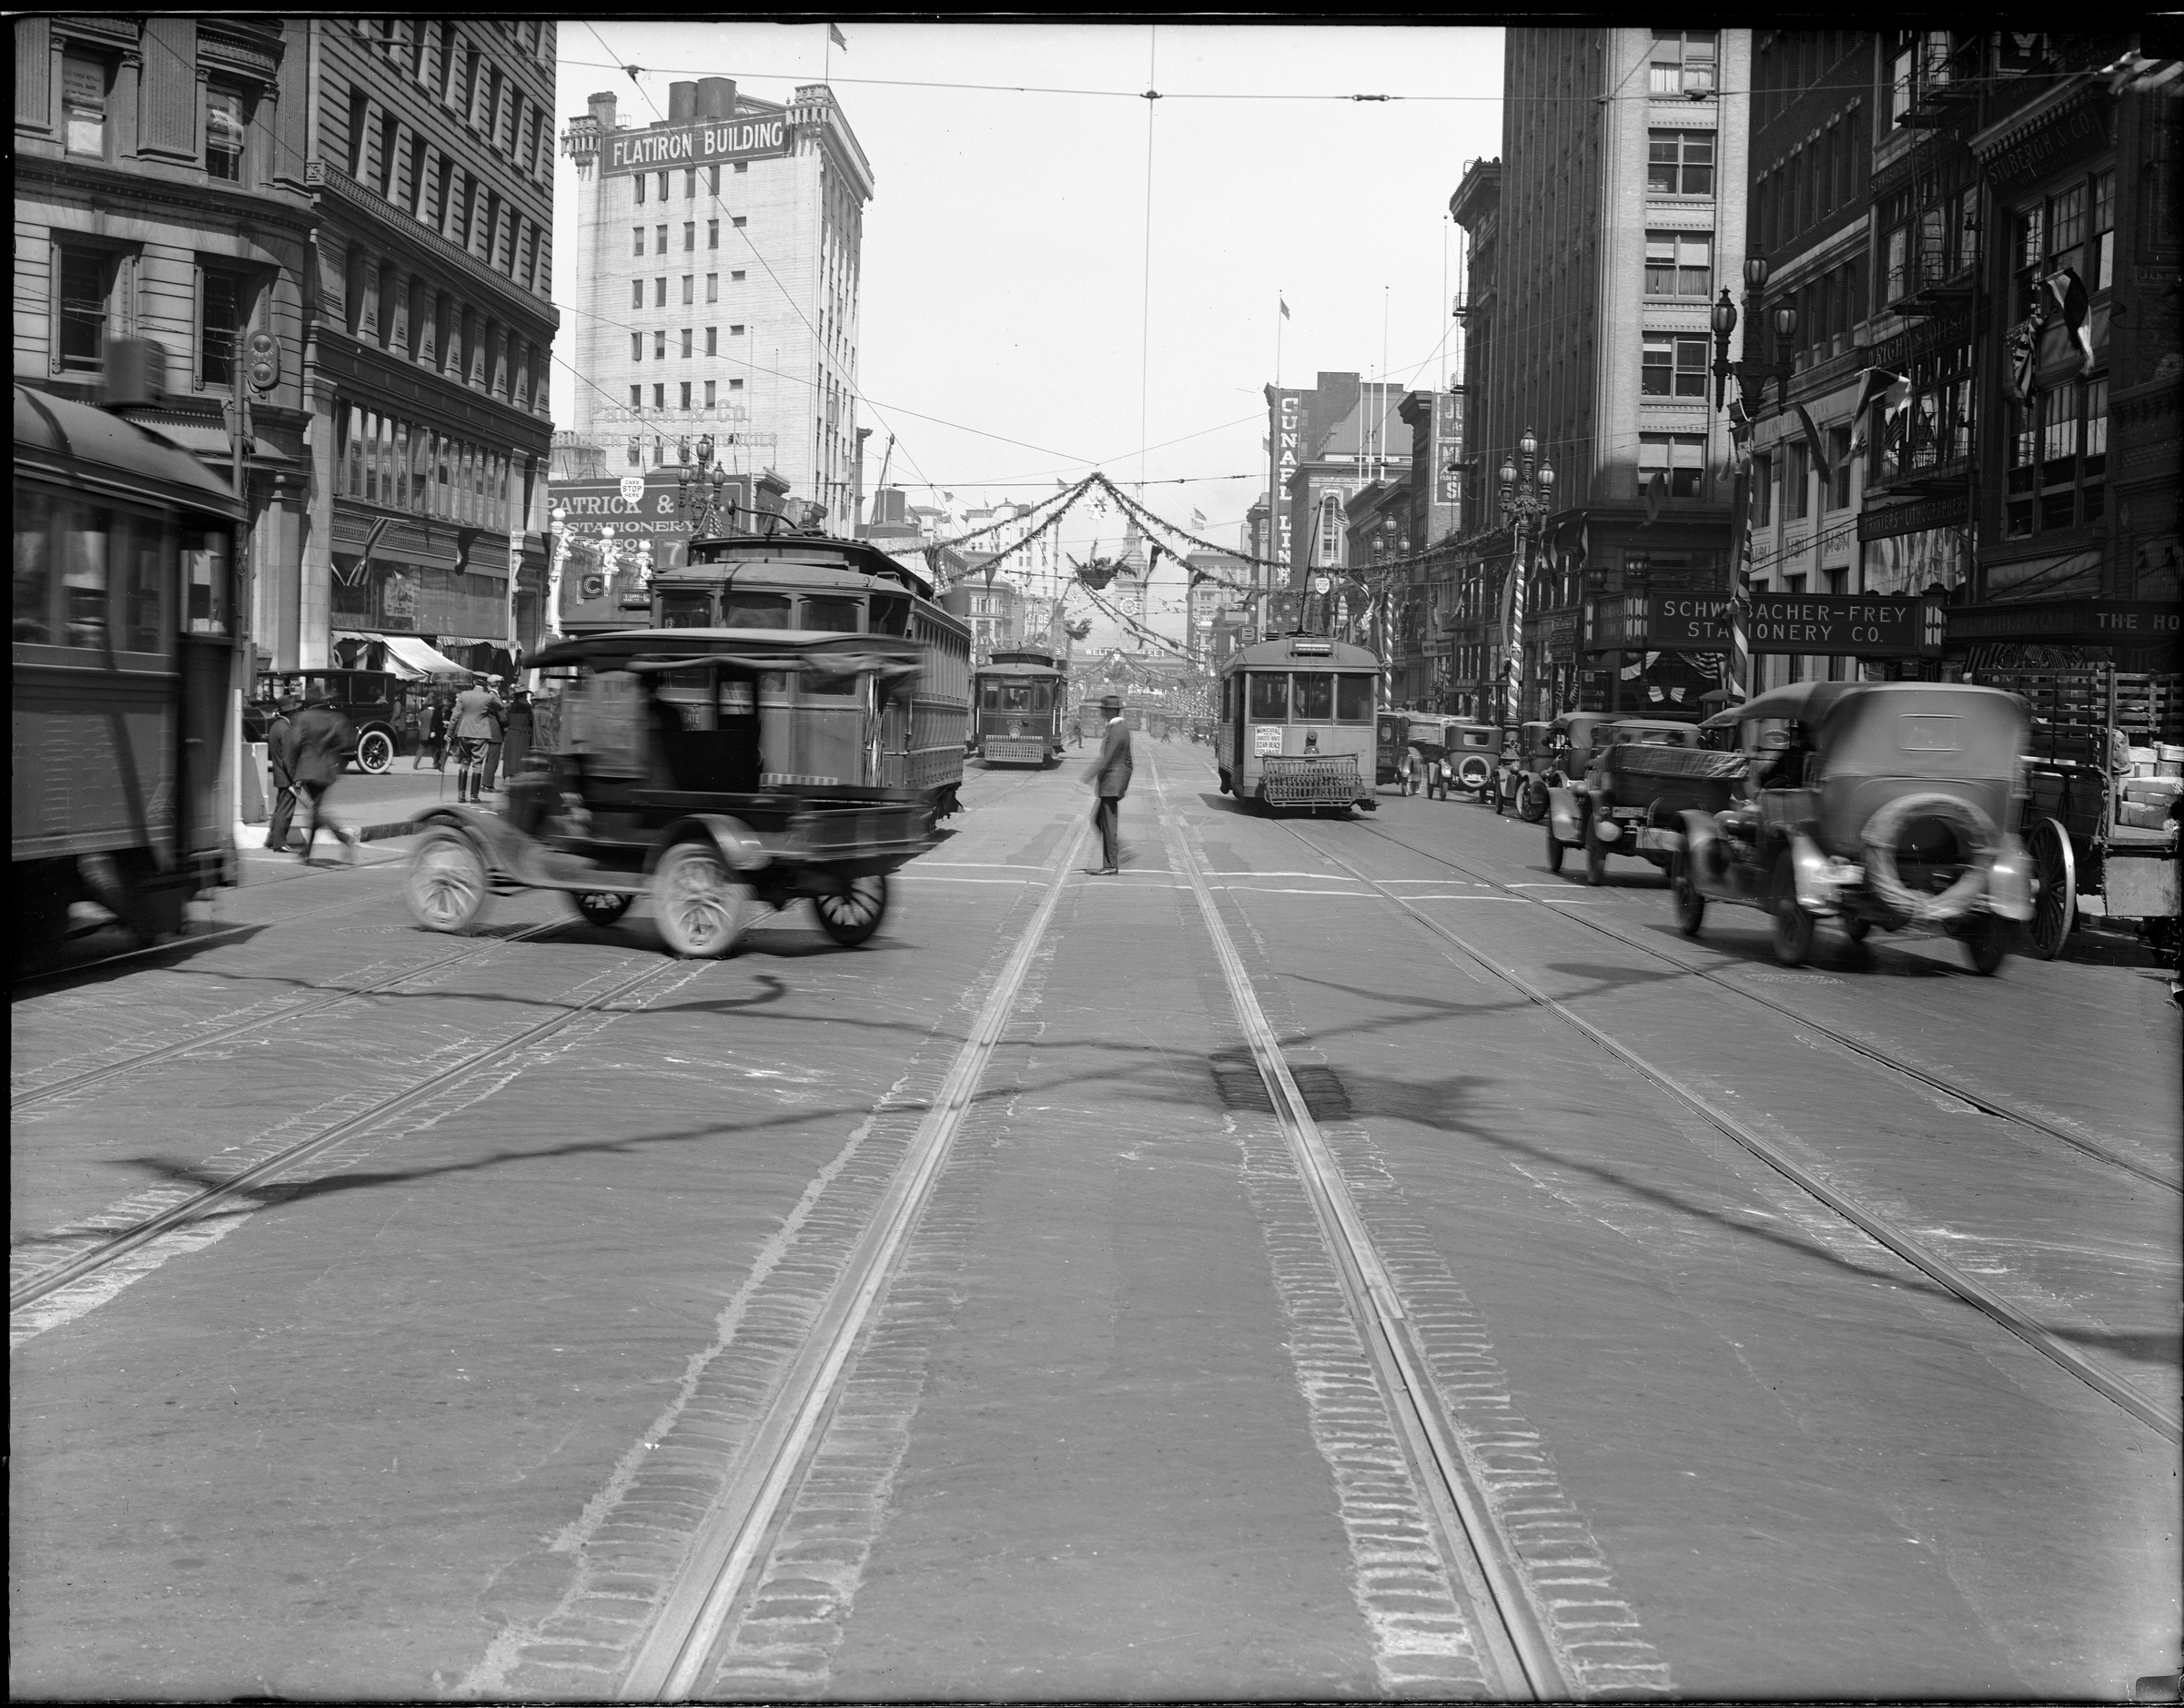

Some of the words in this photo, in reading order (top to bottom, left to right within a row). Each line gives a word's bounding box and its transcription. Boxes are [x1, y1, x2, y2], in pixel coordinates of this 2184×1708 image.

[613, 132, 693, 167] FLATIRON
[704, 121, 784, 155] BUILDING
[1988, 132, 2054, 185] STUBERGH
[2056, 126, 2068, 147] &
[2069, 112, 2096, 138] CO.
[589, 399, 676, 423] Patrick
[689, 399, 705, 423] &
[717, 399, 752, 423] Co.
[556, 432, 621, 448] RUBBER
[628, 432, 693, 448] STAMPS
[548, 496, 642, 515] PATRICK
[656, 494, 675, 515] &
[1905, 496, 1968, 526] LITHOGRAPHERS
[567, 520, 695, 533] STATIONERY
[663, 541, 682, 565] 7
[583, 576, 602, 594] C
[1663, 600, 1907, 623] SCHWBACHER-FREY
[2097, 612, 2138, 630] THE
[1241, 627, 1256, 641] B
[1688, 622, 1834, 641] STAIONERY
[1852, 628, 1885, 643] CO.
